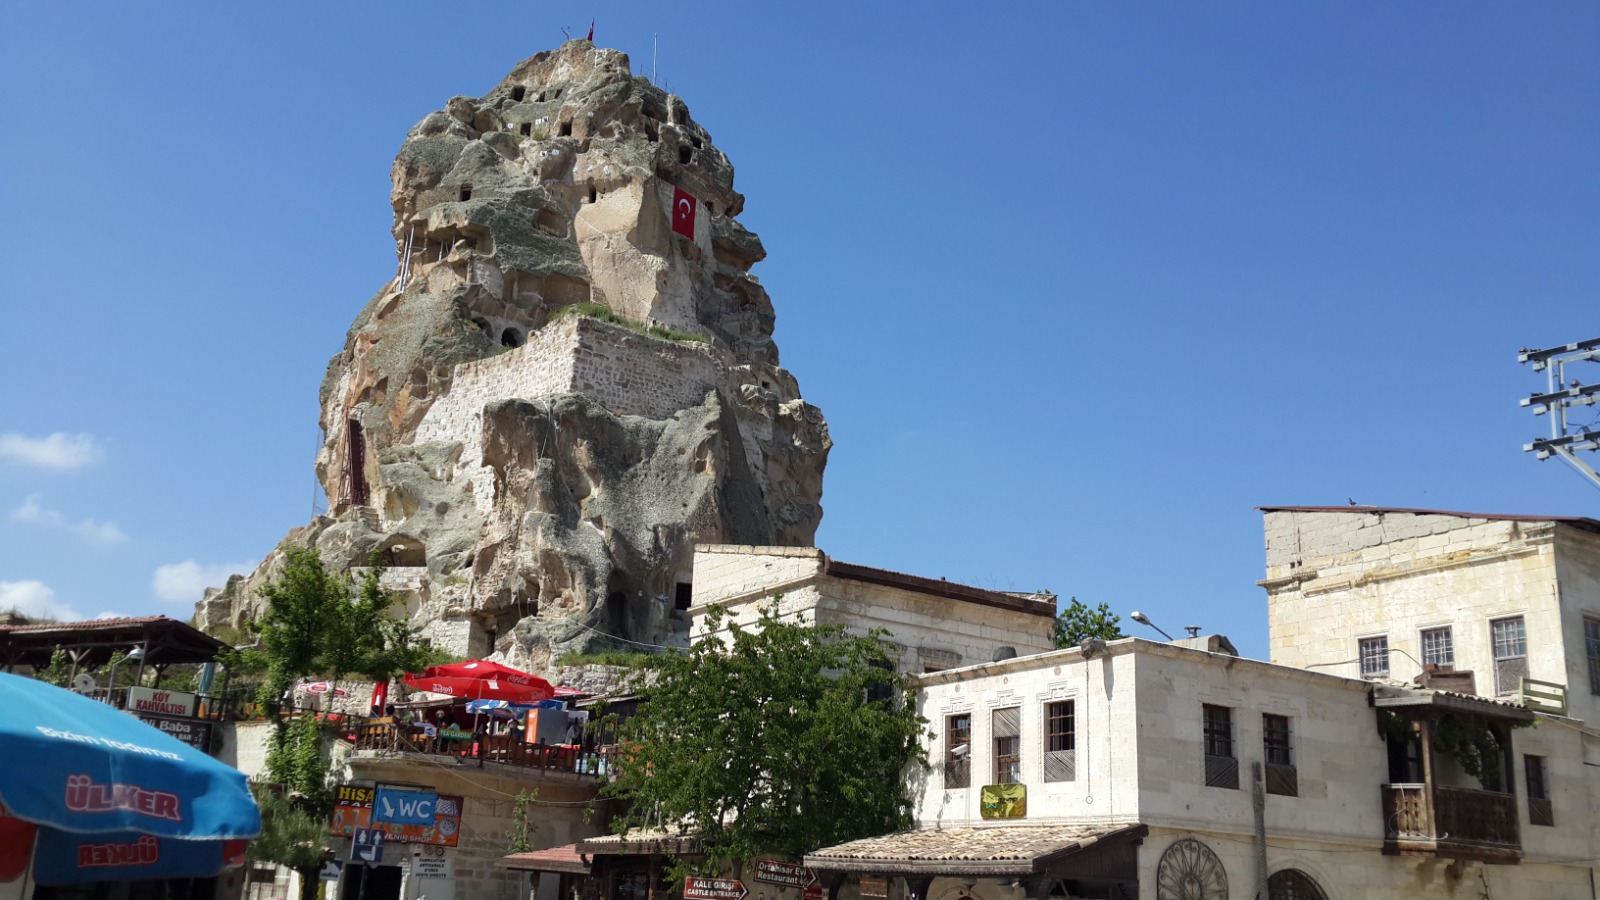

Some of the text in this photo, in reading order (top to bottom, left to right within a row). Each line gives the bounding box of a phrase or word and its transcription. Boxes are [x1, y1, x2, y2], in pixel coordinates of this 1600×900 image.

[152, 691, 170, 703] KÖY
[135, 699, 186, 714] KAHVALTISI
[159, 720, 191, 733] Baba
[450, 731, 472, 739] GARDEN
[66, 774, 182, 821] ÜLKER
[399, 798, 431, 819] WC
[409, 835, 433, 843] SHOP
[758, 862, 793, 874] Ortahisar
[757, 870, 798, 885] Restaurant
[693, 880, 712, 889] KALE
[687, 888, 740, 898] CASTLE ENTRANCE
